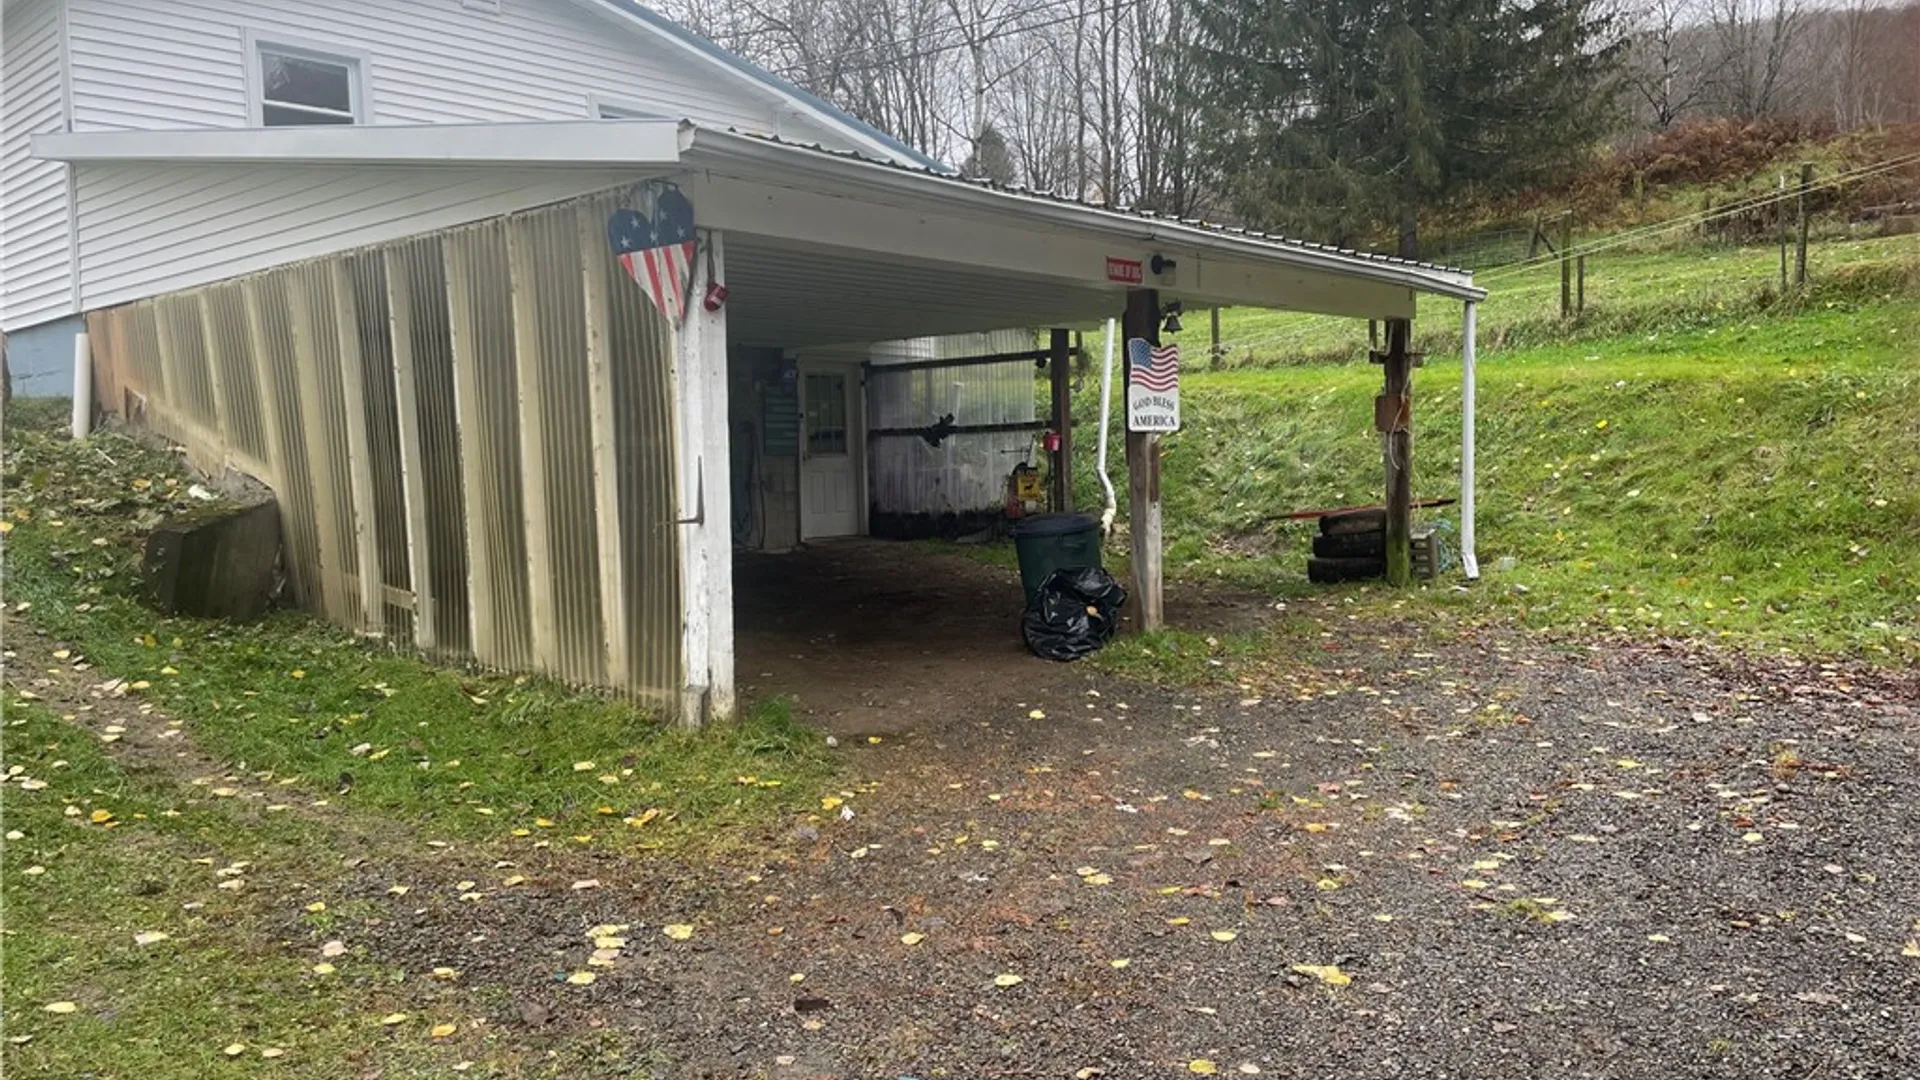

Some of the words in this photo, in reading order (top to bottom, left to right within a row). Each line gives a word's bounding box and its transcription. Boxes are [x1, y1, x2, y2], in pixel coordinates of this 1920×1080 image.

[1132, 396, 1152, 410] GOD
[1153, 396, 1175, 411] BLESS
[1133, 415, 1175, 426] AMERICA
